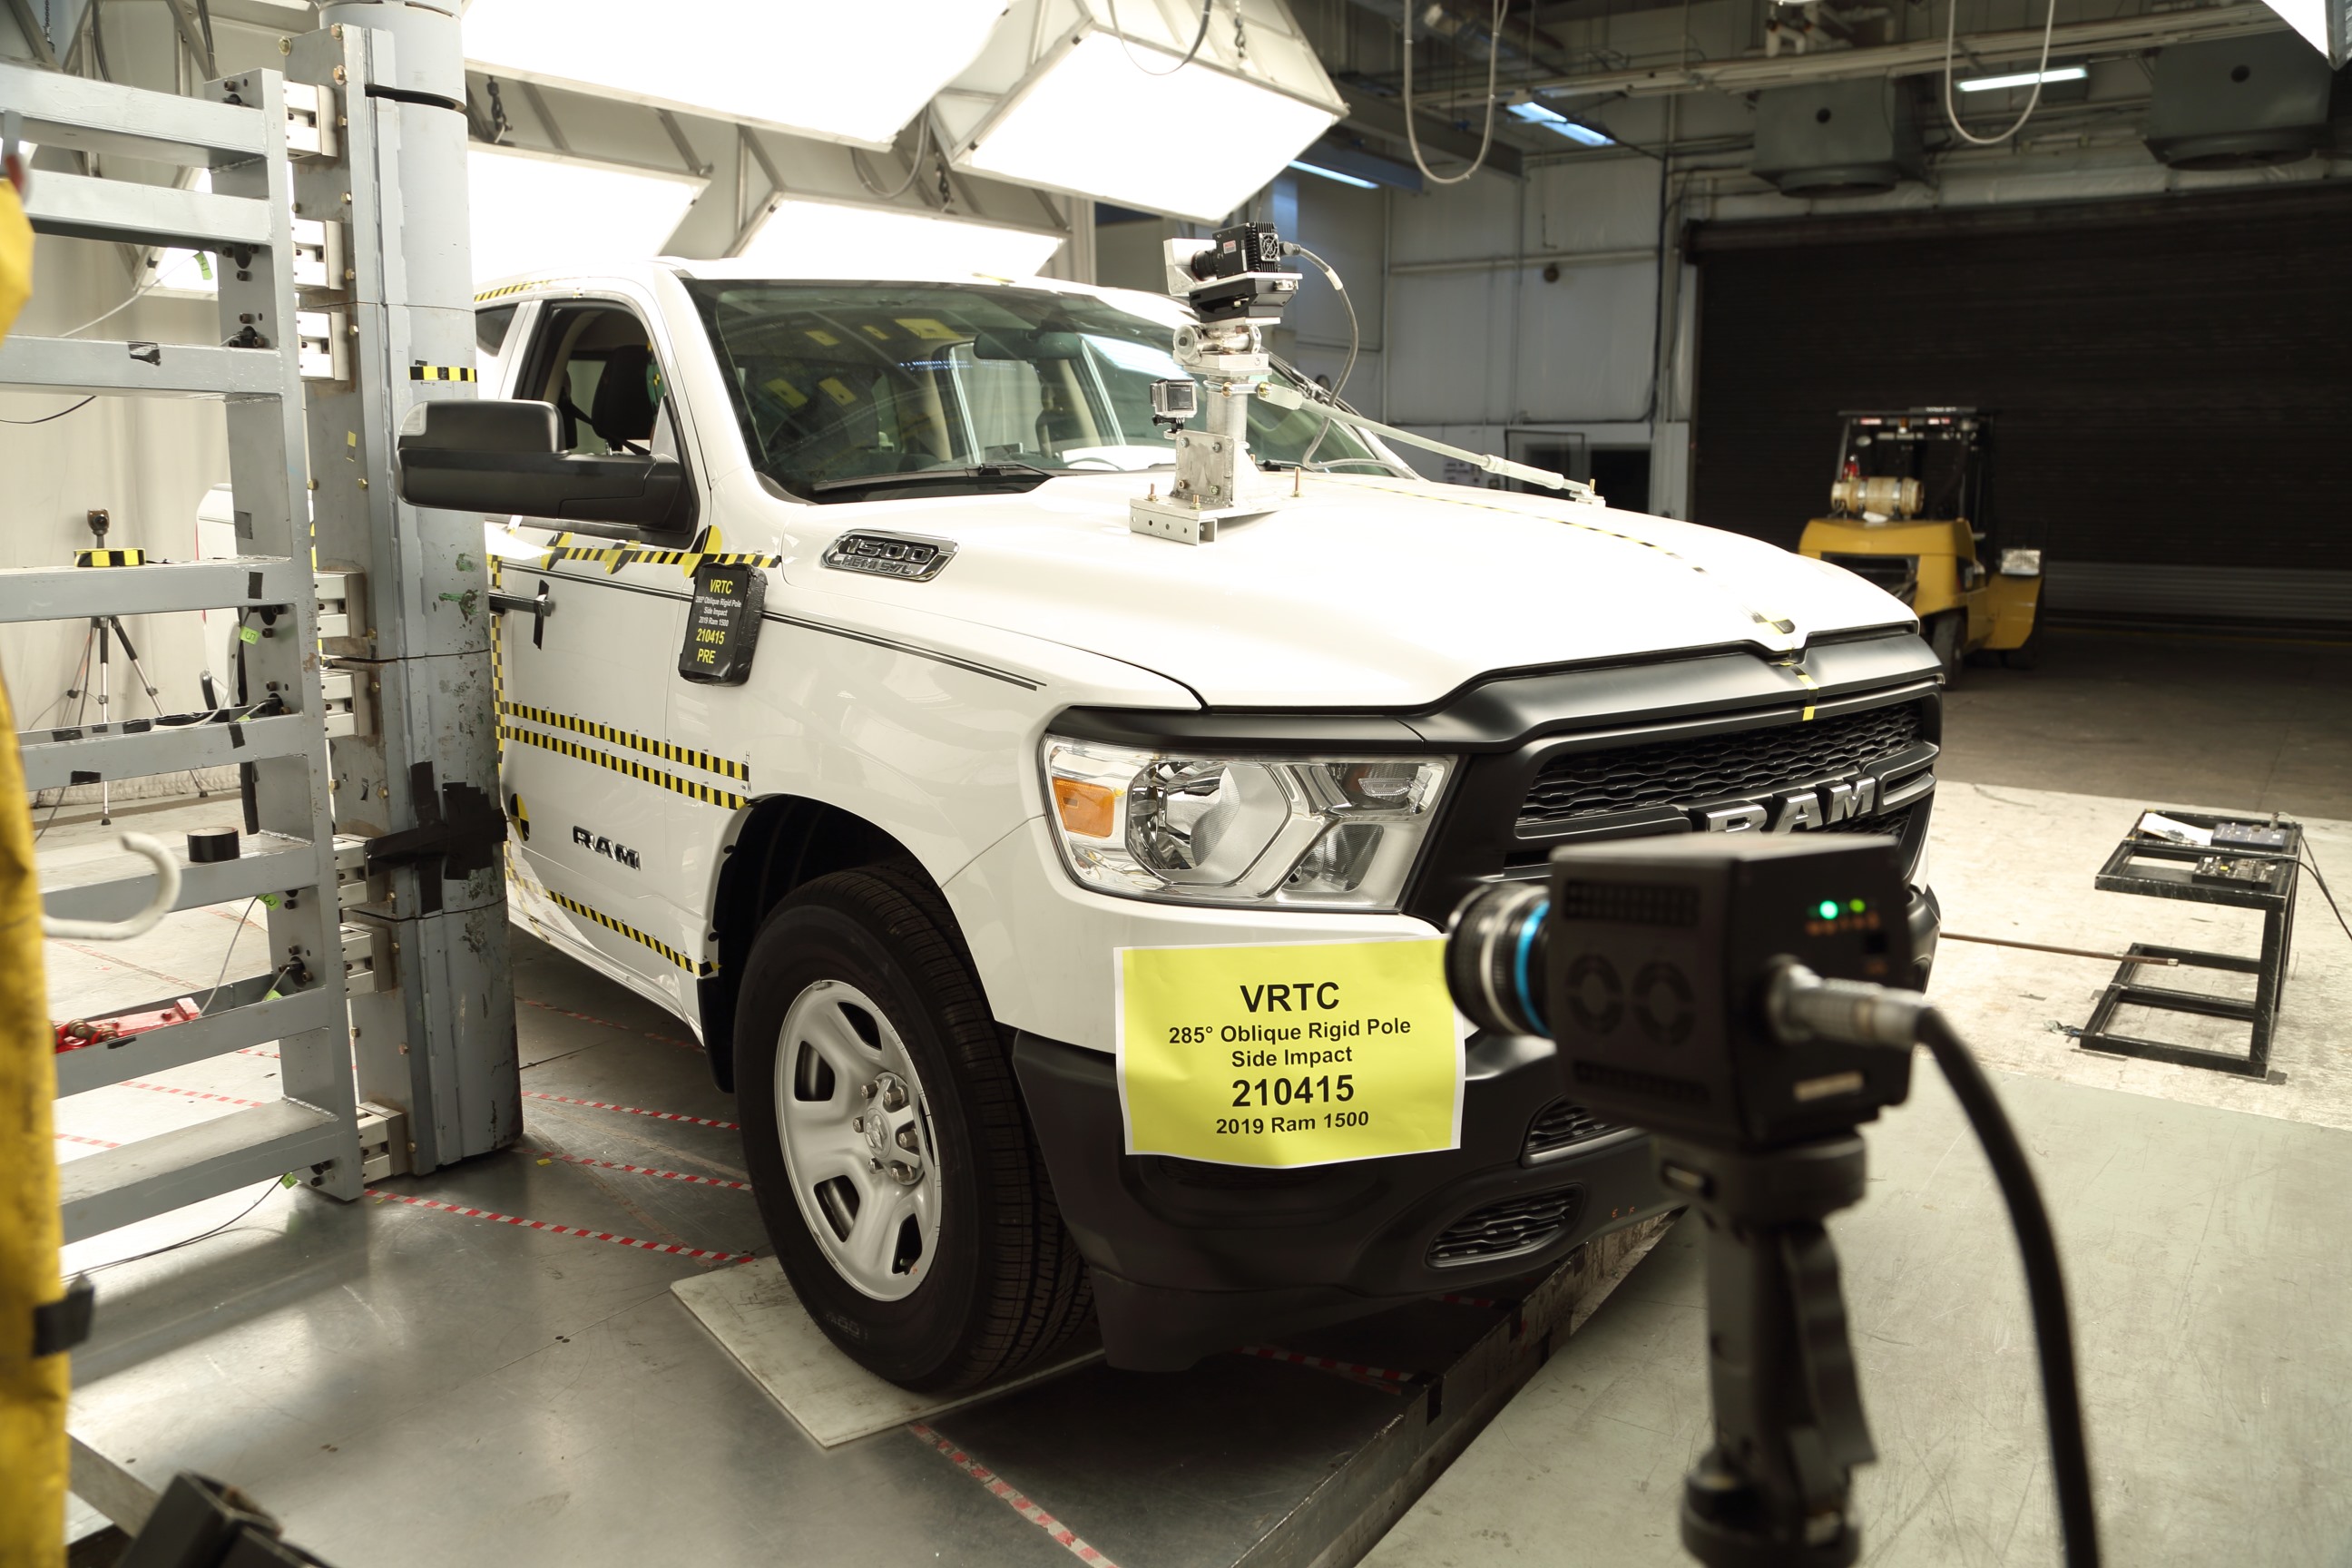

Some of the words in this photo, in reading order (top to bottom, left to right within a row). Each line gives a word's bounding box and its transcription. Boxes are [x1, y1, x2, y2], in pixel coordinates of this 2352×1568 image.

[846, 537, 935, 564] 1500
[842, 554, 877, 571] HEMI
[879, 561, 914, 575] 5.7L
[710, 579, 733, 594] VRTC
[703, 606, 713, 614] Side
[713, 608, 728, 617] Impact
[704, 596, 720, 606] Oblique
[720, 598, 732, 608] Rigid
[731, 599, 742, 608] Pole
[699, 615, 709, 624] 2019
[709, 617, 718, 625] Ram
[719, 619, 730, 627] 1500
[696, 628, 726, 645] 210415
[697, 648, 716, 664] PRE
[1690, 775, 1877, 837] RAM
[573, 825, 641, 872] RAM
[1240, 981, 1340, 1013] VRTC
[1169, 1025, 1213, 1044] 285°
[1220, 1024, 1301, 1045] Oblique
[1308, 1019, 1360, 1042] Rigid
[1367, 1017, 1412, 1035] Pole
[1231, 1049, 1278, 1068] Side
[1284, 1045, 1353, 1068] Impact
[1232, 1073, 1355, 1107] 210415
[1216, 1118, 1264, 1135] 2019
[1271, 1115, 1316, 1133] Ram
[1323, 1110, 1369, 1129] 1500
